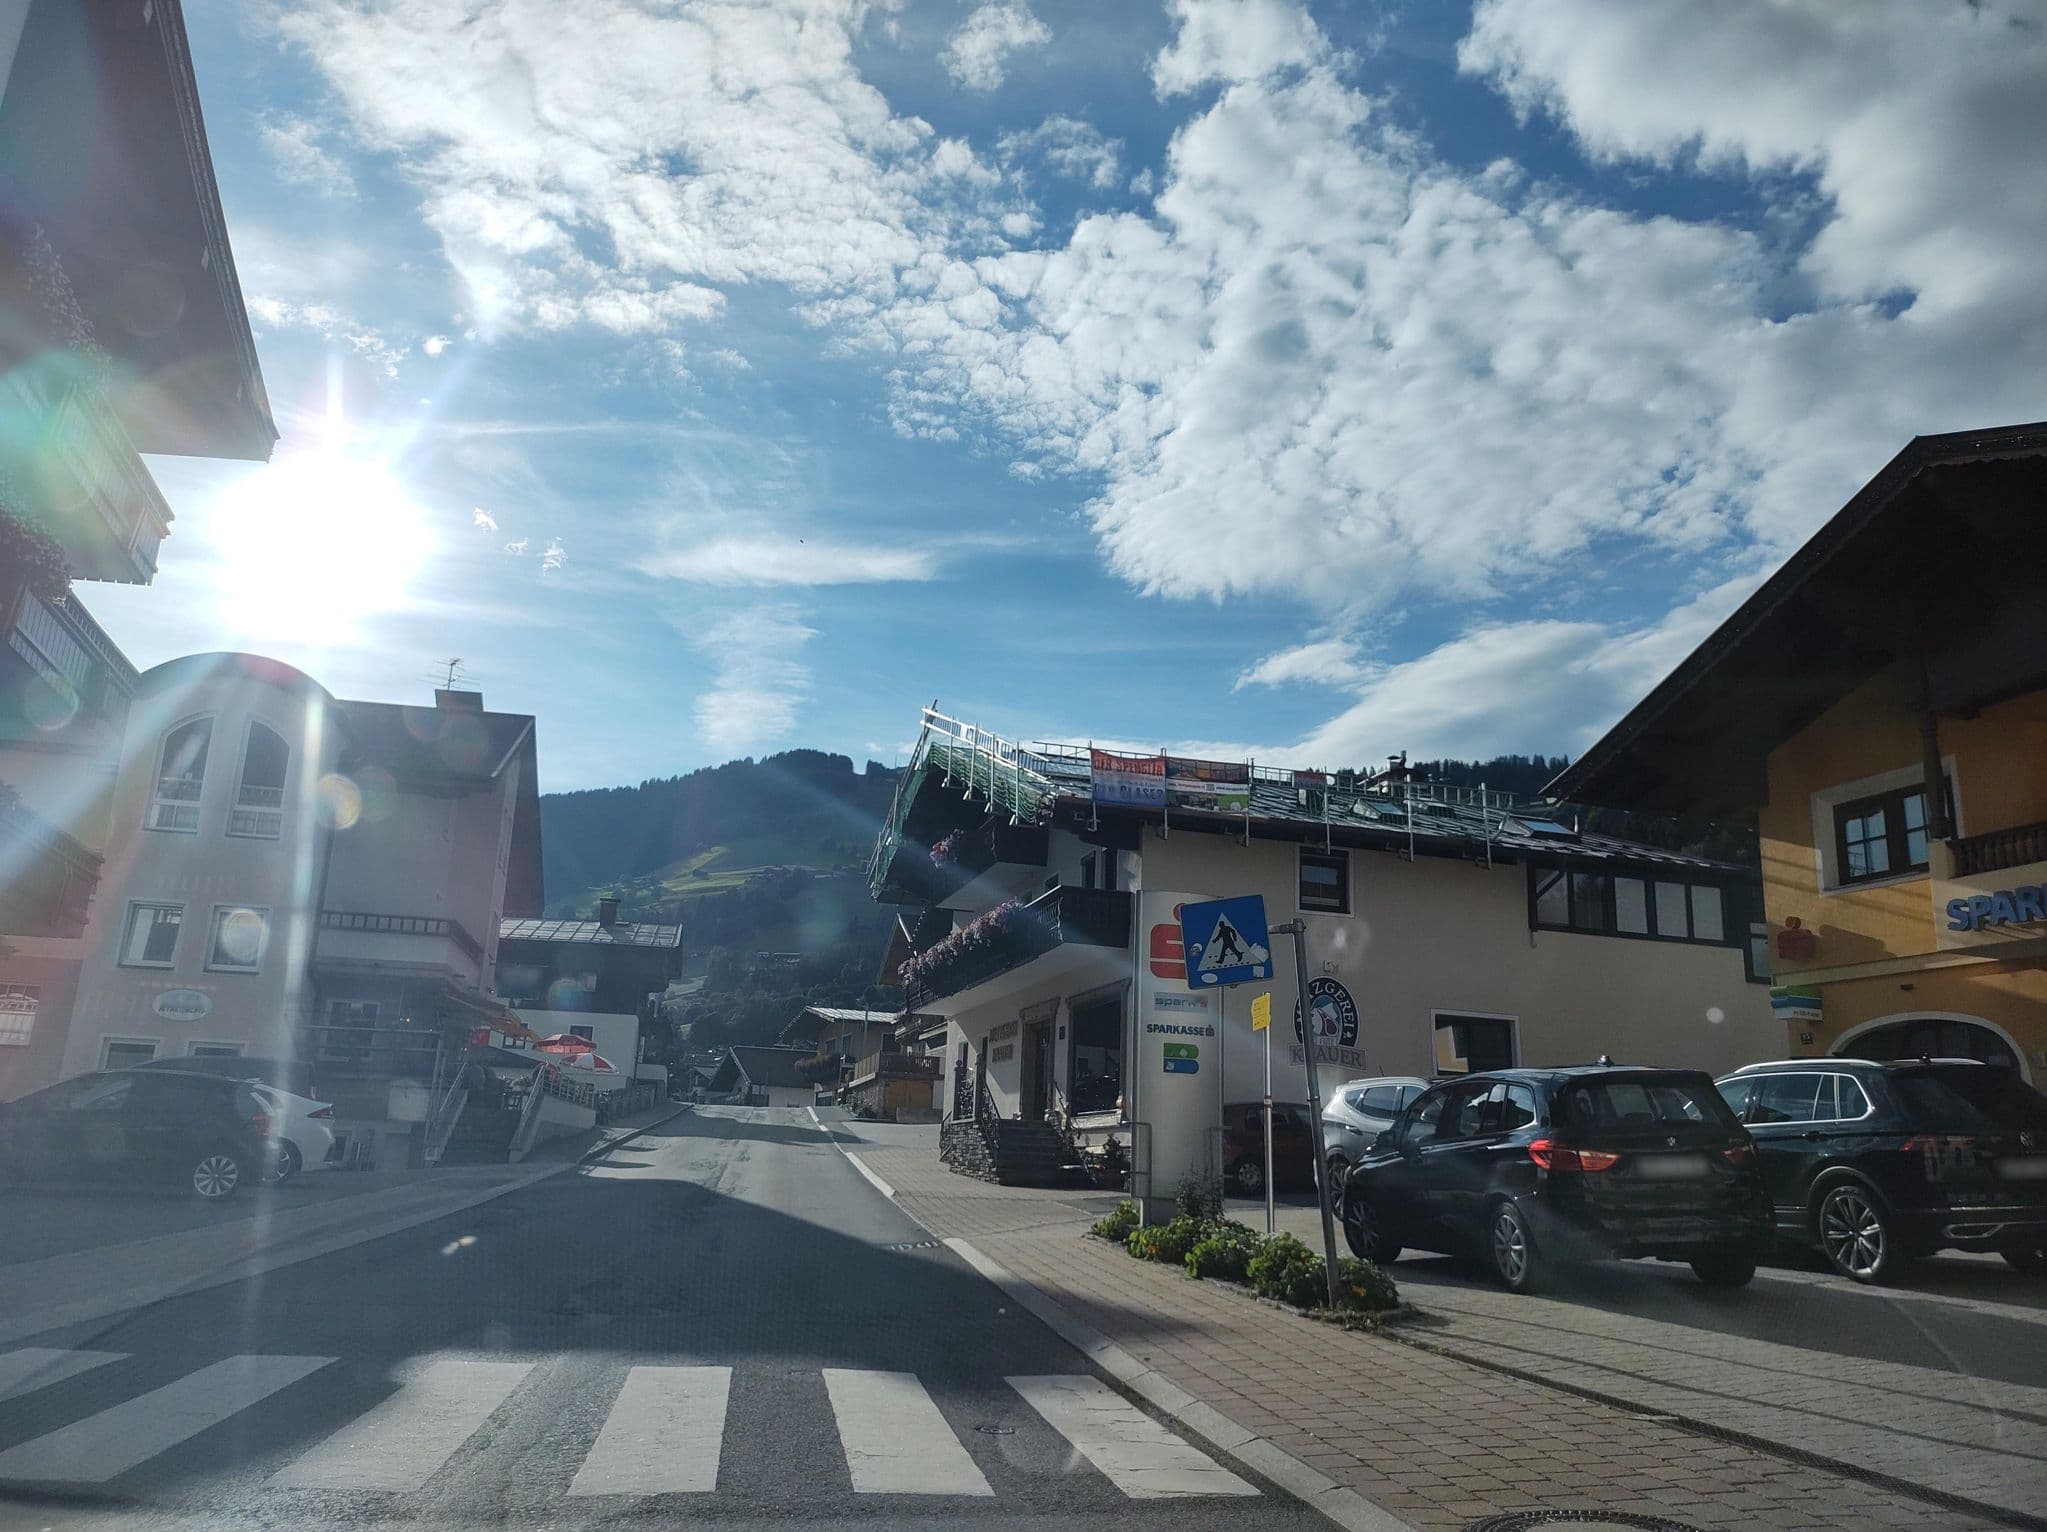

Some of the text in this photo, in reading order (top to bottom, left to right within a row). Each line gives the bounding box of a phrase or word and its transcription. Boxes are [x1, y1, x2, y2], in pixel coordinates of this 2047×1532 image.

[1946, 883, 2047, 932] SPAR
[1296, 981, 1356, 1027] ZGEREI
[1146, 1023, 1205, 1036] SPARKASSE
[1290, 1044, 1362, 1067] KAUER
